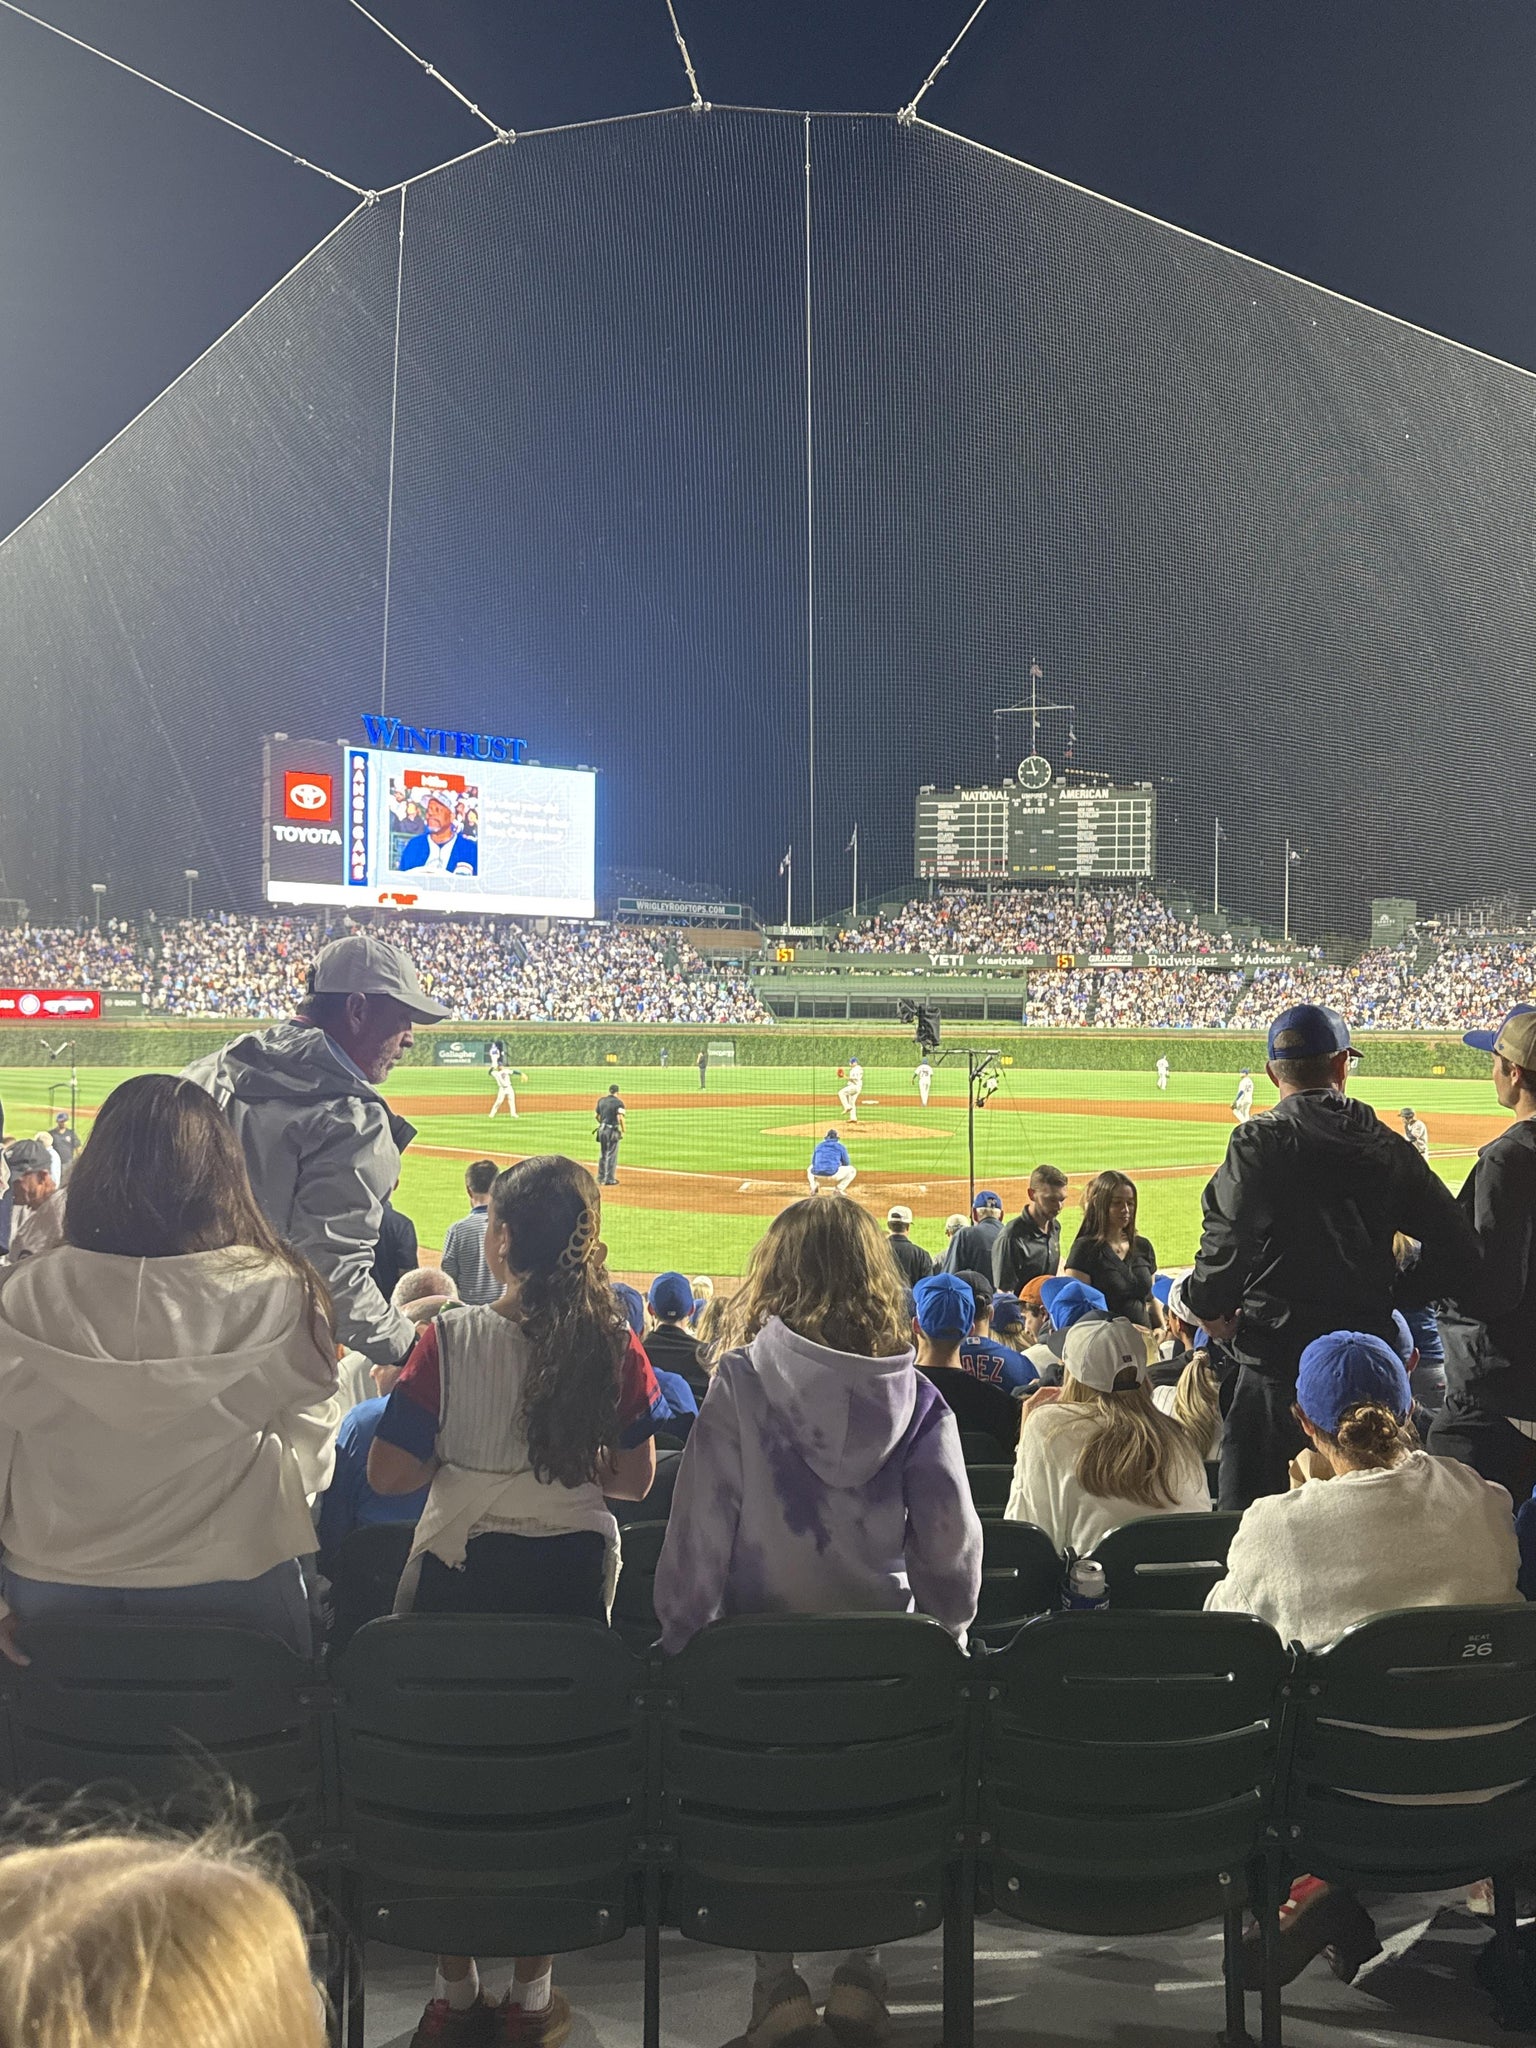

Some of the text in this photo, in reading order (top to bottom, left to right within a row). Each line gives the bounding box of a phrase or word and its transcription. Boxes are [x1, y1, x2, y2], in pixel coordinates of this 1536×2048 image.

[360, 713, 528, 764] WINTRUST
[961, 790, 1010, 801] NATIONAL
[1058, 788, 1110, 800] AMERICAN
[272, 825, 343, 846] TOYOTA
[928, 954, 964, 966] YETI
[983, 956, 1034, 967] tastytrade
[1088, 954, 1134, 962] GRAINGER
[1244, 953, 1292, 965] Advocate
[438, 1050, 476, 1059] Gallagher
[961, 1354, 1005, 1383] AEZ
[1461, 1642, 1493, 1658] 26
